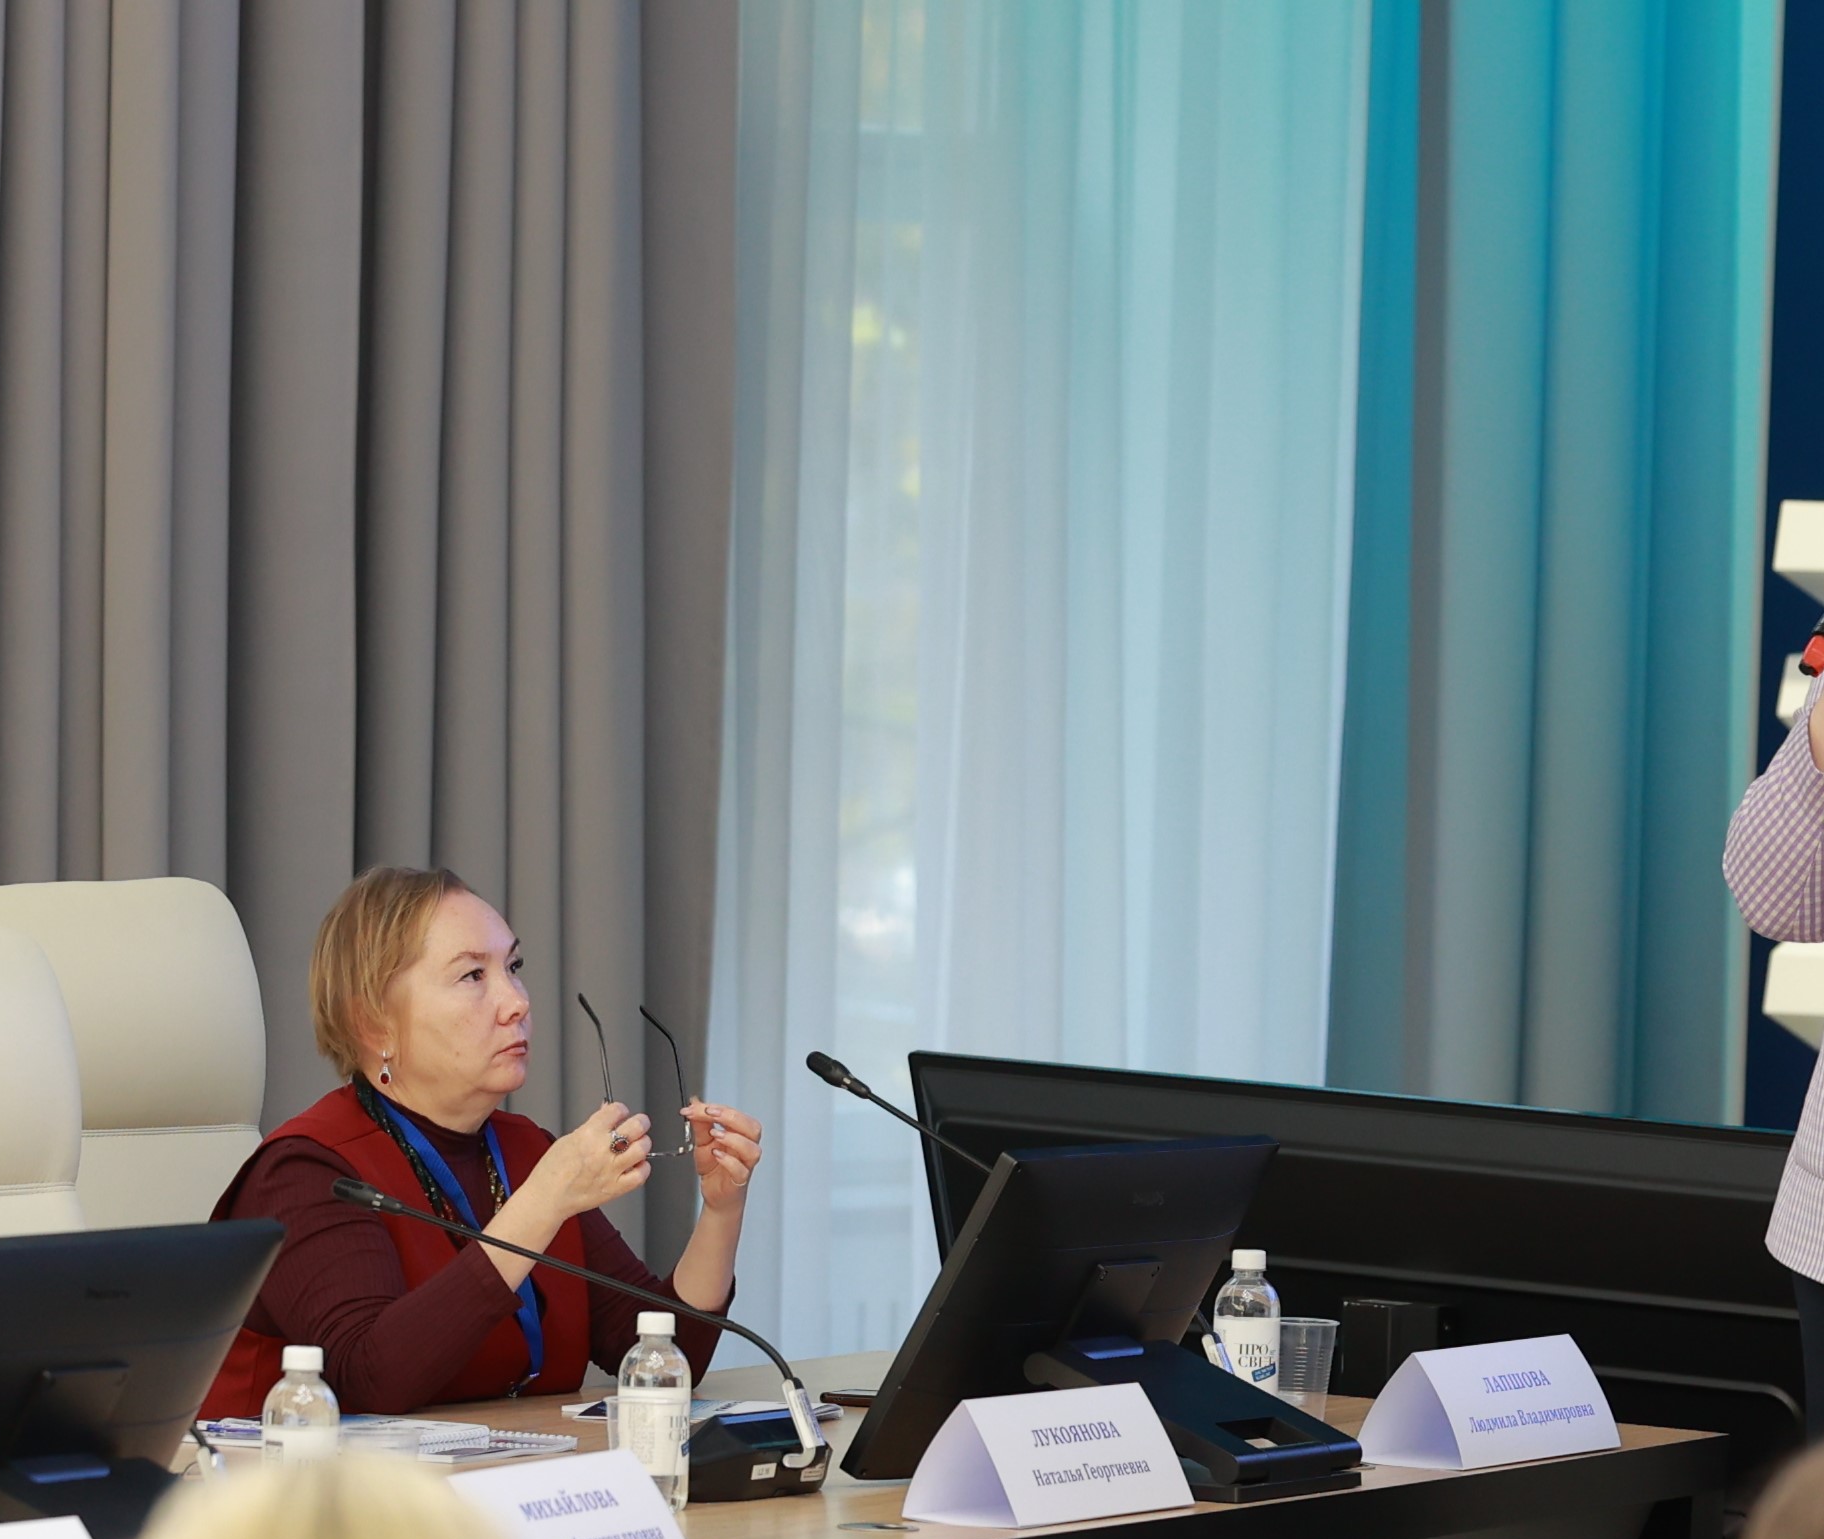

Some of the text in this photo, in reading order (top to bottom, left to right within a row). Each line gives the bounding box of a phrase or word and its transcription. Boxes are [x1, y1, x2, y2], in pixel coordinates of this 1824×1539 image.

[1239, 1344, 1269, 1355] ПРО
[1482, 1369, 1551, 1394] ЛАПШОВА
[1469, 1403, 1596, 1434] Людмила Владимировна
[1032, 1420, 1122, 1448] ЛУКОЯНОВА
[1032, 1459, 1152, 1487] Наталья Георгиевна
[519, 1489, 620, 1522] МИХАЙЛОВА
